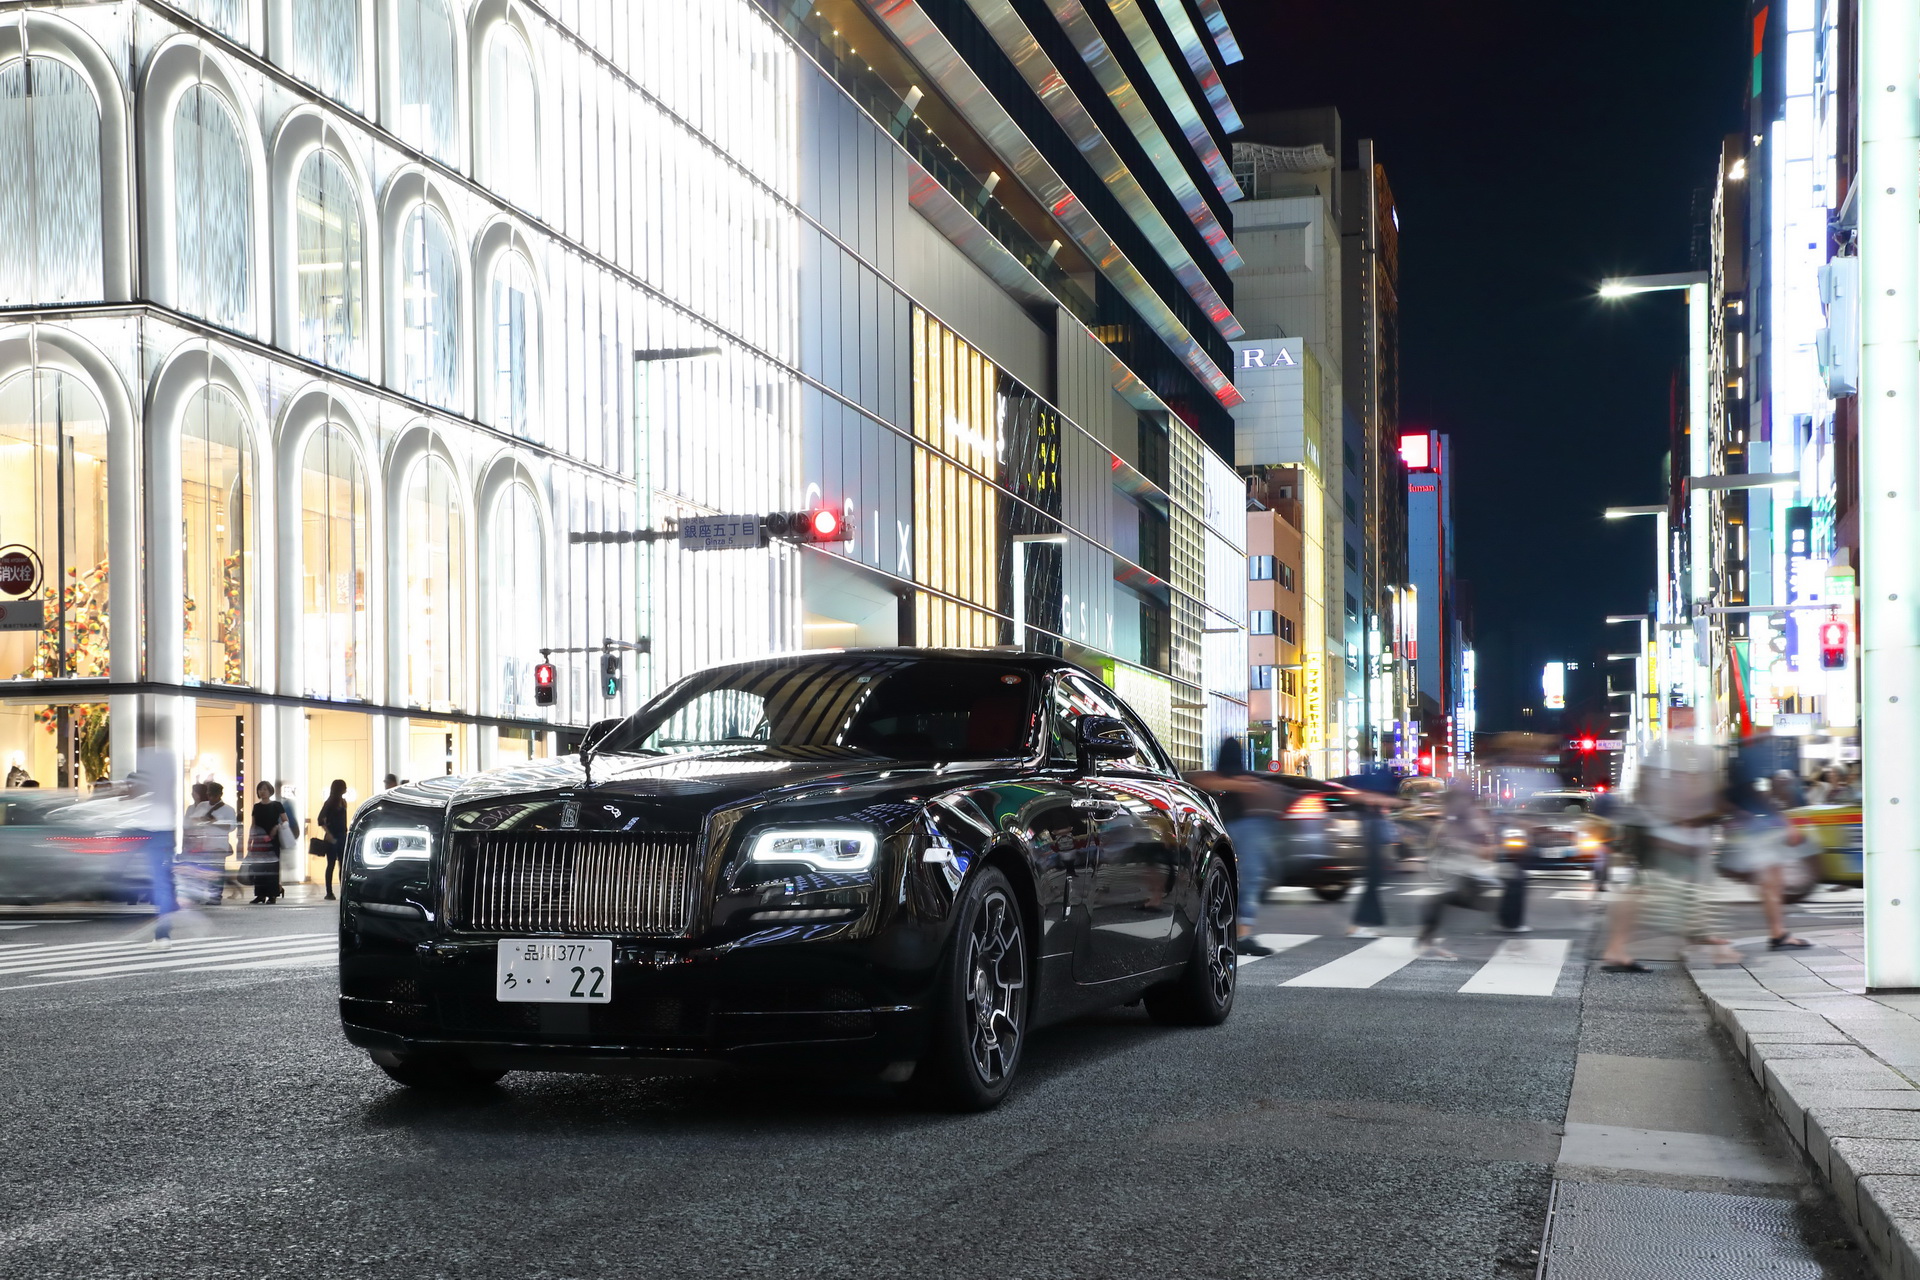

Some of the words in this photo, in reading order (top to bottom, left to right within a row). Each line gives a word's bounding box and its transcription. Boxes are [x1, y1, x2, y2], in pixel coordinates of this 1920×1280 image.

[1234, 347, 1298, 369] RA
[684, 522, 754, 538] 銀座五丁目
[728, 537, 733, 545] 5
[0, 565, 32, 582] 消火栓
[504, 972, 518, 989] ろ
[570, 966, 605, 998] 22
